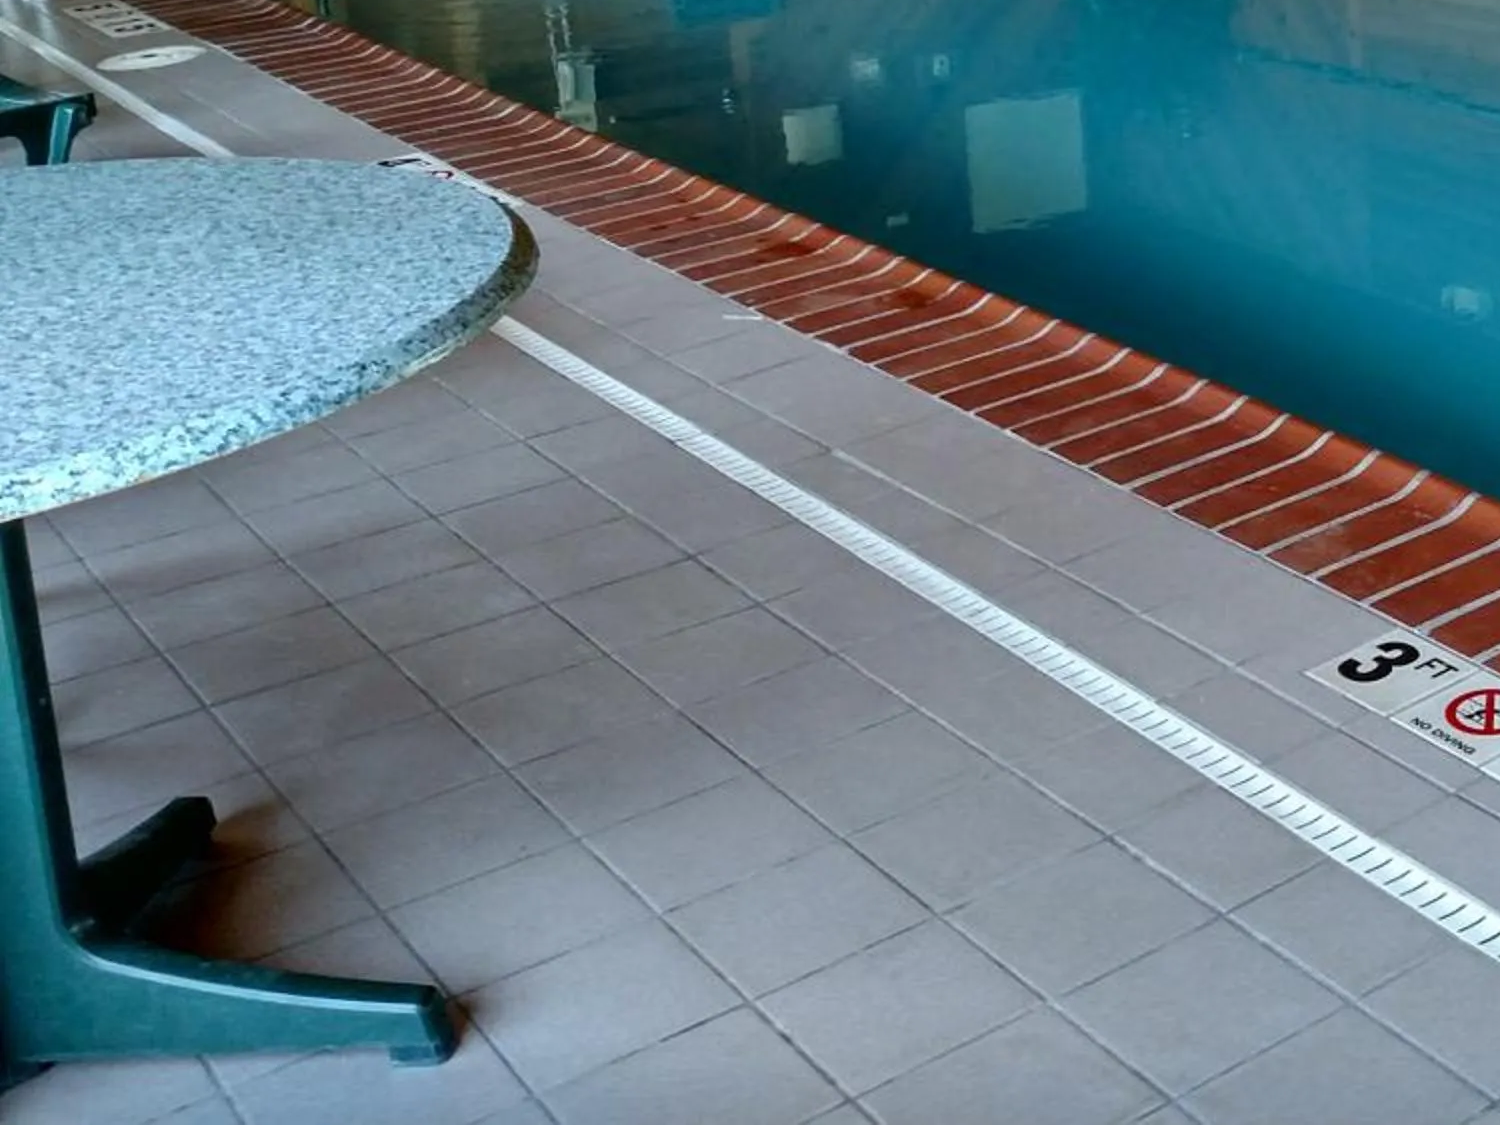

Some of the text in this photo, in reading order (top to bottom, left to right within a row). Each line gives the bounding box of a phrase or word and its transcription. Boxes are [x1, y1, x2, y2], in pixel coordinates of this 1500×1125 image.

[1337, 641, 1460, 683] 3 FT
[1408, 716, 1477, 755] NO DIVING
